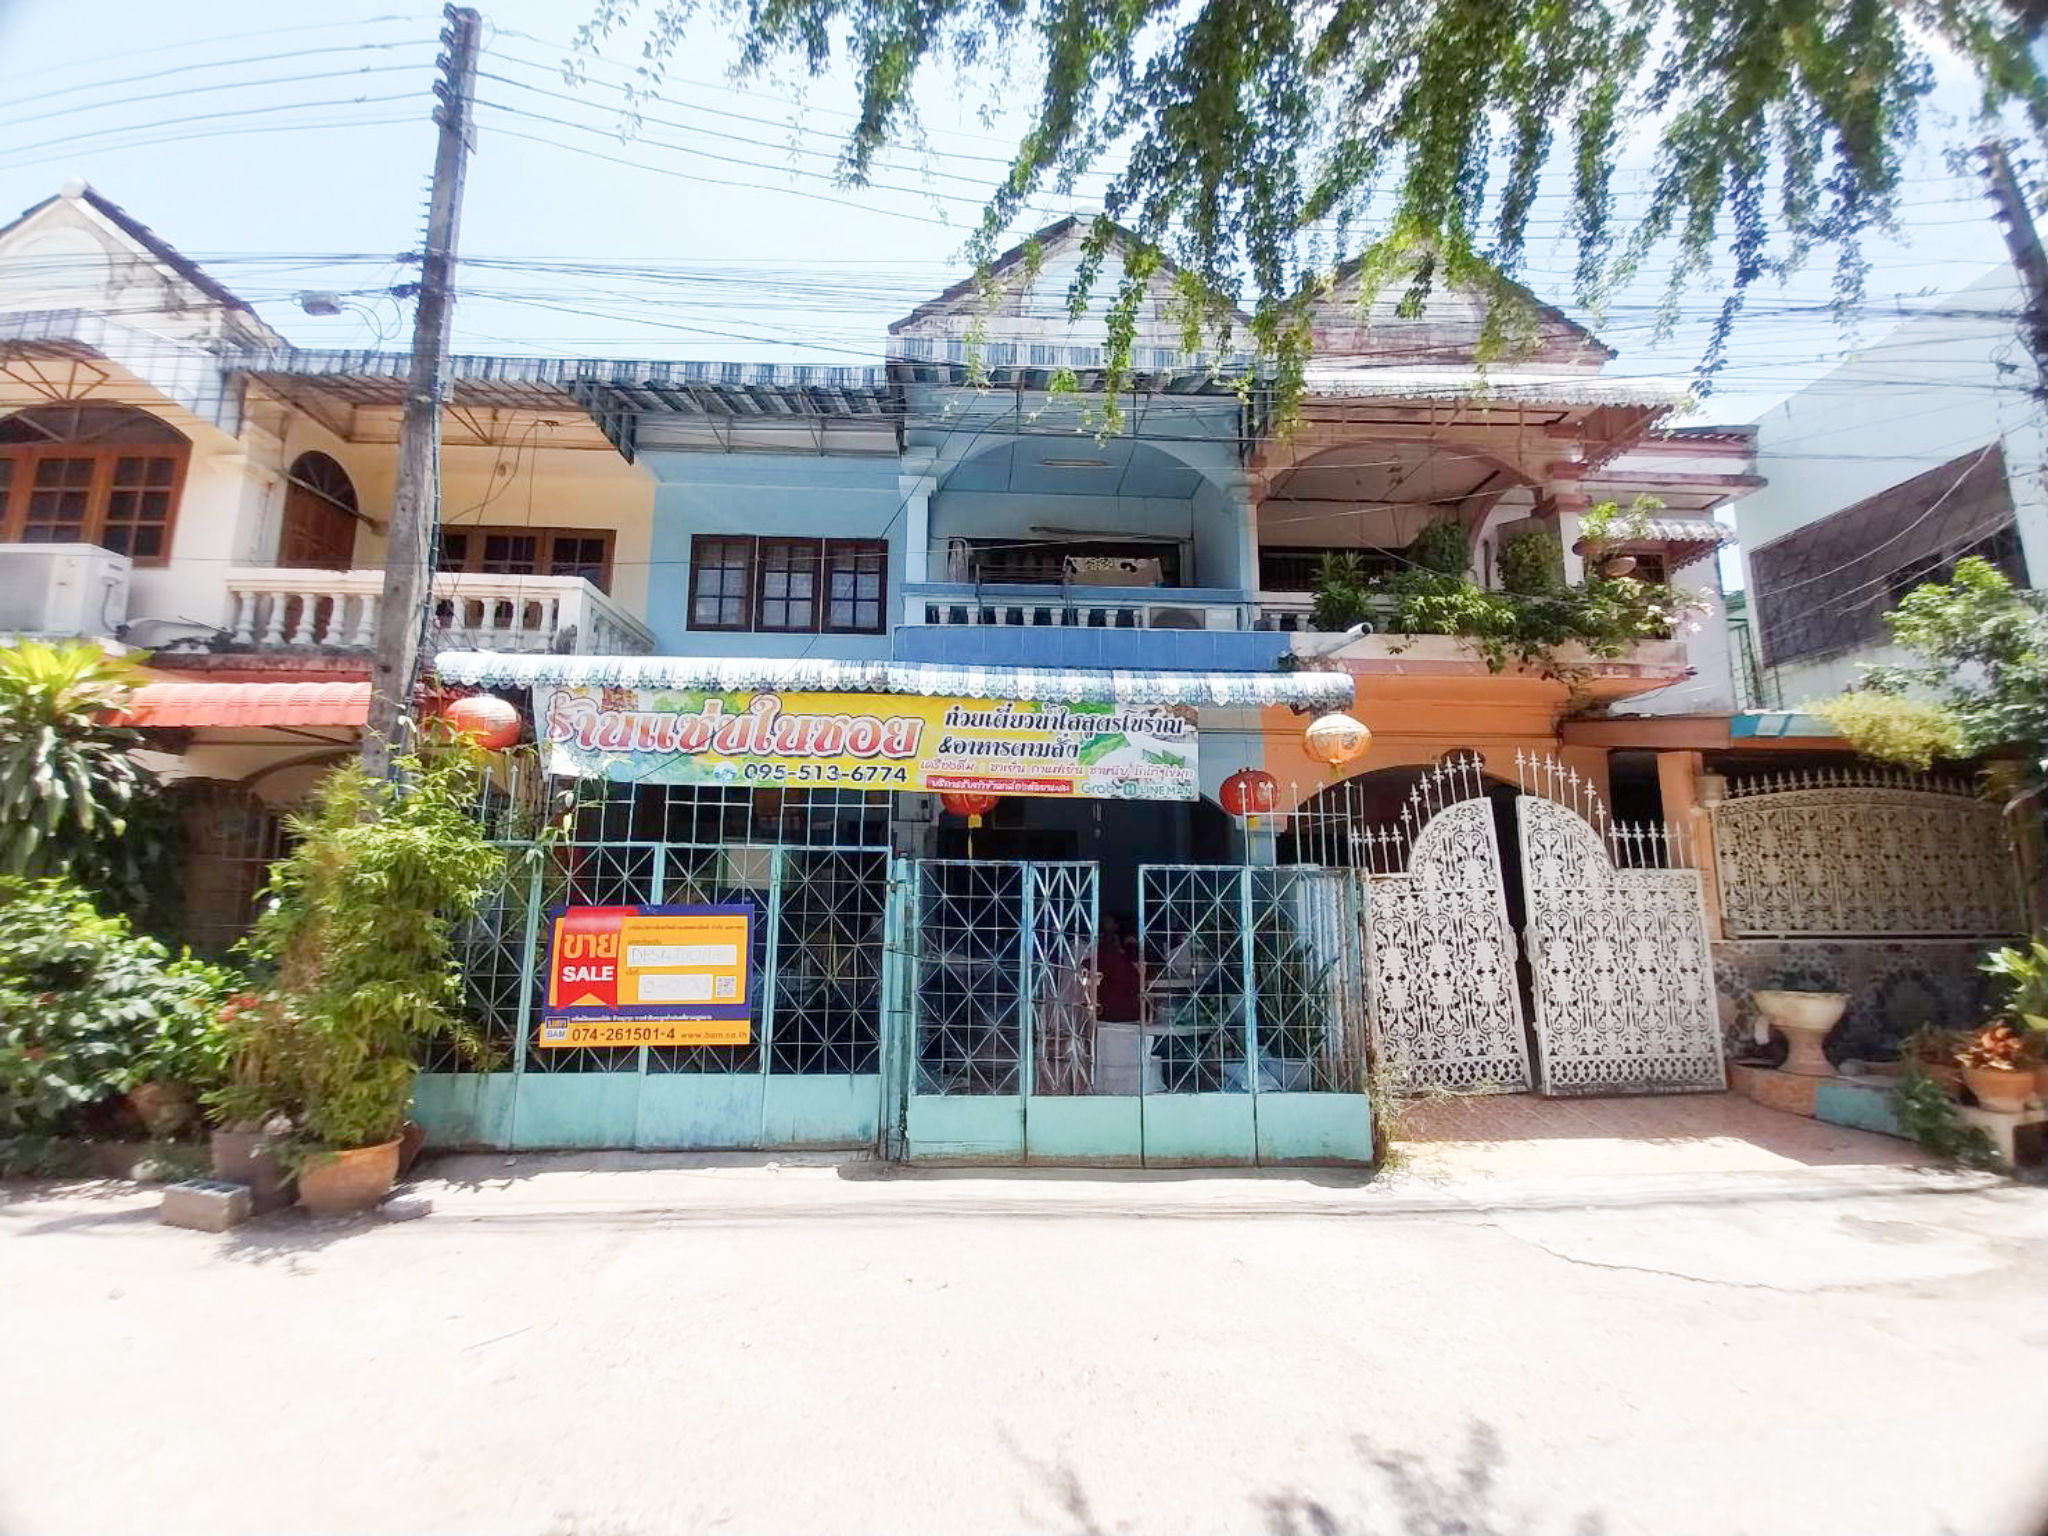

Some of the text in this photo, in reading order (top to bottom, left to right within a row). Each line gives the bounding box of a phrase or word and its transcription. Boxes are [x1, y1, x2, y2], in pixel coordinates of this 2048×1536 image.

[743, 764, 907, 782] 095-513-6774
[1081, 782, 1116, 794] Grab
[563, 933, 617, 959] ขาย
[562, 965, 614, 982] SALE
[572, 1027, 675, 1041] 074-261501-4
